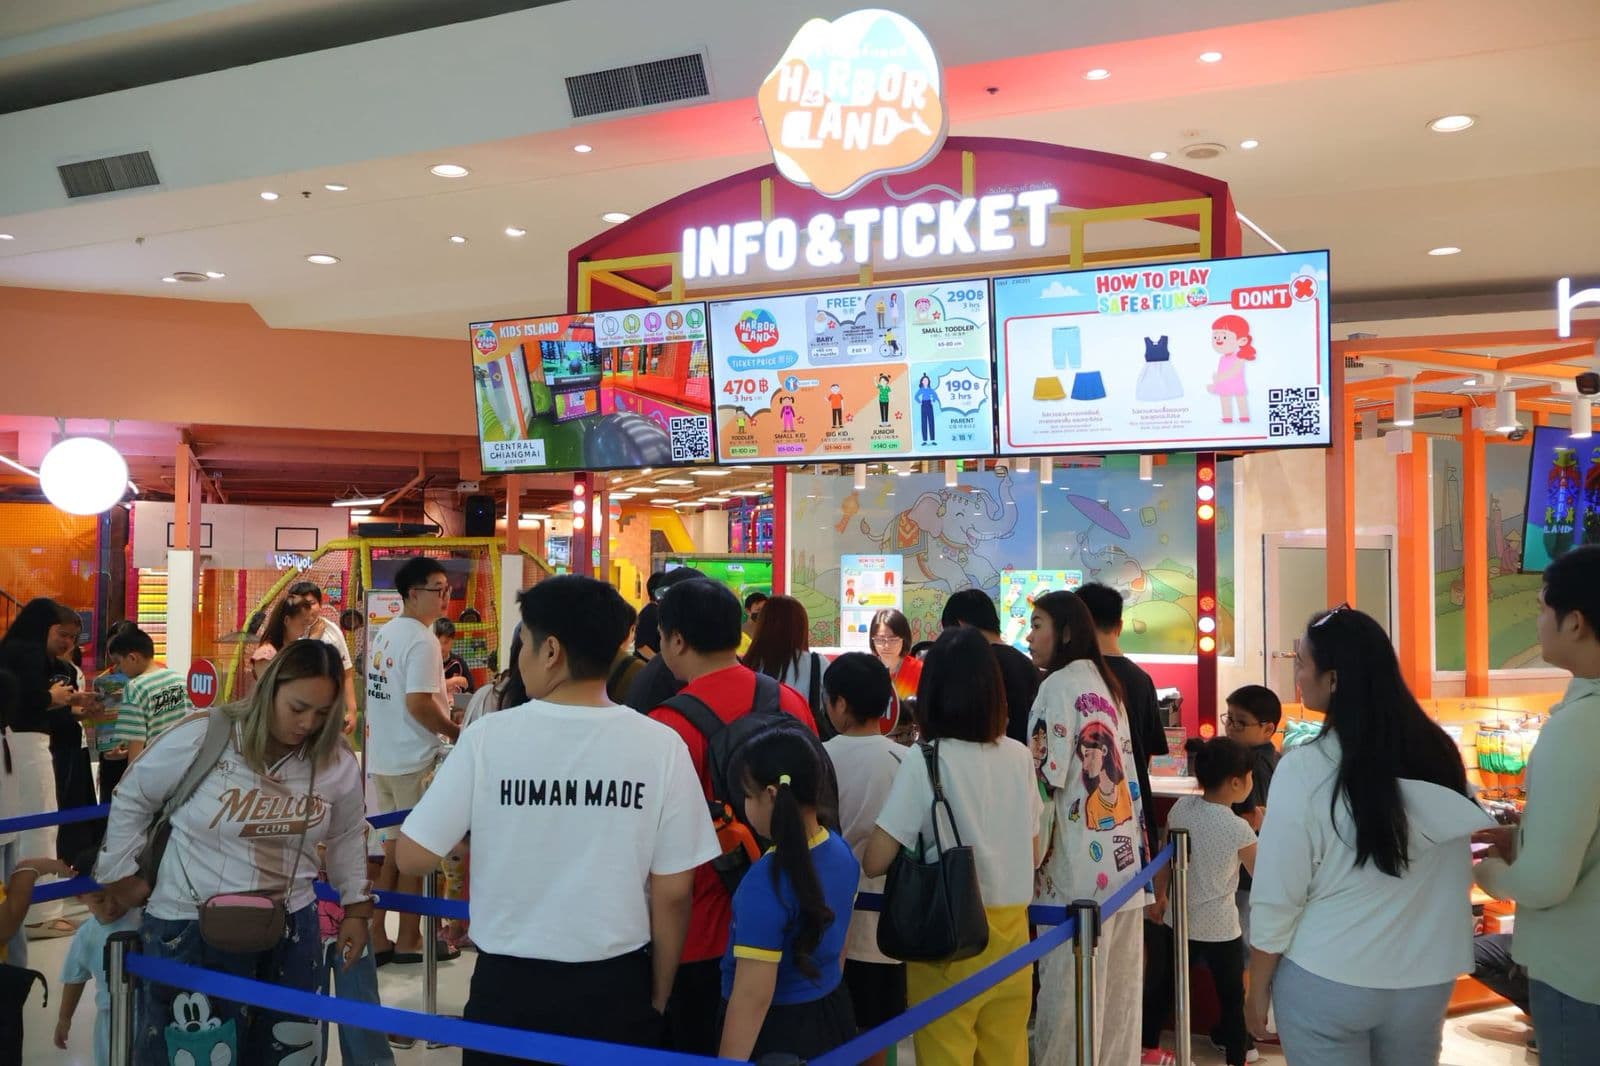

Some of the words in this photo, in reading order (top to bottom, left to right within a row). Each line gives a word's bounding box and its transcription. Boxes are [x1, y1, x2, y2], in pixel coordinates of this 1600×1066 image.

[777, 60, 928, 109] HARBOR
[781, 102, 915, 150] LAND
[682, 218, 797, 279] INFO
[805, 214, 844, 267] &
[844, 188, 1059, 263] TICKET
[1096, 273, 1138, 294] HOW
[1142, 272, 1164, 288] TO
[1169, 268, 1209, 287] PLAY
[1099, 295, 1139, 313] SAFE
[1141, 297, 1150, 310] &
[1152, 291, 1186, 310] FUN
[1238, 287, 1288, 308] DON'T
[500, 324, 521, 338] KIDS
[524, 321, 559, 336] ISLAND
[740, 320, 776, 334] HARBOR
[741, 329, 773, 343] LAND
[733, 359, 756, 369] TICKET
[723, 379, 756, 395] 470
[945, 380, 972, 392] 190
[958, 392, 972, 400] hrs
[494, 442, 534, 451] CENTRAL
[490, 451, 540, 460] CHIANGMAI
[191, 673, 213, 695] OUT
[500, 779, 578, 806] HUMAN
[584, 779, 646, 810] MADE
[255, 824, 290, 834] CLUB
